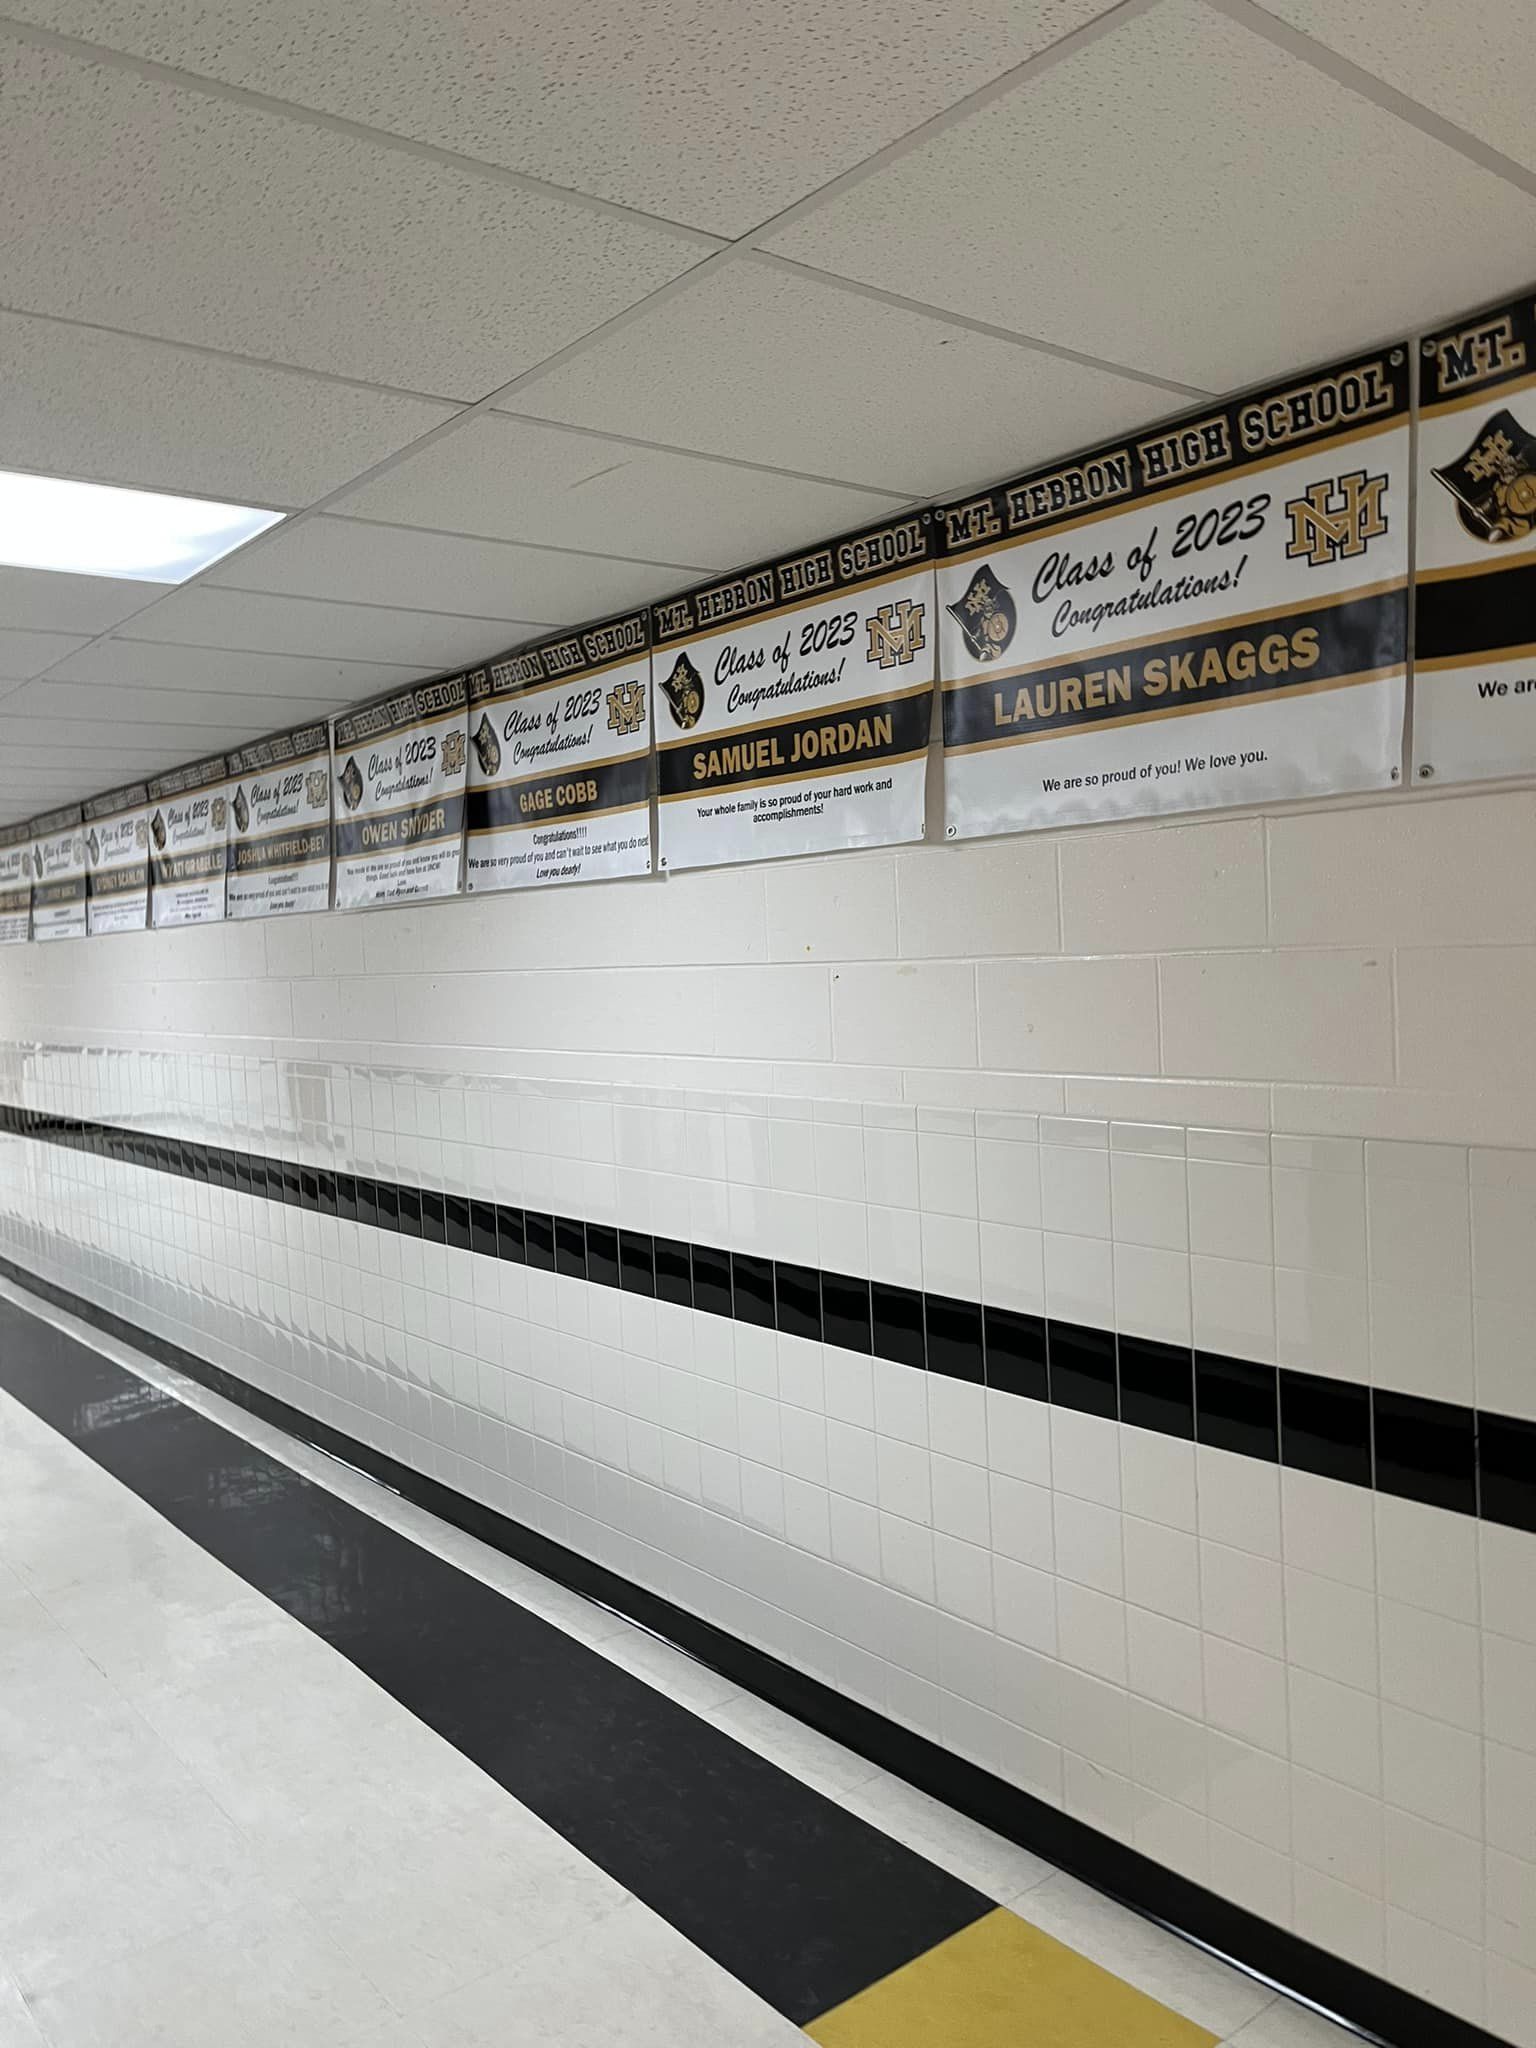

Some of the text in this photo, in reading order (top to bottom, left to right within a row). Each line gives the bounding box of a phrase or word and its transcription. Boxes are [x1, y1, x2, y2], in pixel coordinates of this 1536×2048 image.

[1438, 315, 1526, 393] MT.
[947, 362, 1393, 548] MT. HEBRON HIGH SCHOOL
[1032, 493, 1271, 604] Class of 2023
[659, 520, 926, 637] MT. HEBRON HIGH SCHOOL
[1051, 554, 1248, 638] Congratulations!
[468, 617, 646, 698] MT. HEBRON HIGH SCHOOL
[715, 611, 857, 685] Class of 2023
[415, 678, 465, 715] SCHOOL
[727, 657, 846, 713] Congratulations!
[994, 627, 1321, 726] LAUREN SKAGGS
[1478, 678, 1536, 698] We ar
[504, 688, 602, 741] Class of 2023
[368, 736, 436, 781] Class of 2023
[513, 724, 593, 765] Congratulations!
[693, 714, 893, 780] SAMUEL JORDAN
[1042, 750, 1268, 793] We are so proud of you! We love you.
[520, 780, 598, 813] GAGE COBB
[697, 777, 893, 818] Your whole family is so proud of your hard work and
[753, 803, 824, 823] accomplishments!
[361, 807, 446, 845] OWEN SNYDER
[468, 859, 479, 869] We
[480, 859, 489, 868] are
[510, 853, 527, 867] proud
[527, 852, 534, 862] of
[534, 853, 544, 865] you
[545, 849, 555, 860] and
[585, 844, 591, 855] to
[592, 844, 602, 854] see
[617, 840, 628, 853] you
[629, 836, 637, 848] do
[549, 866, 560, 879] you
